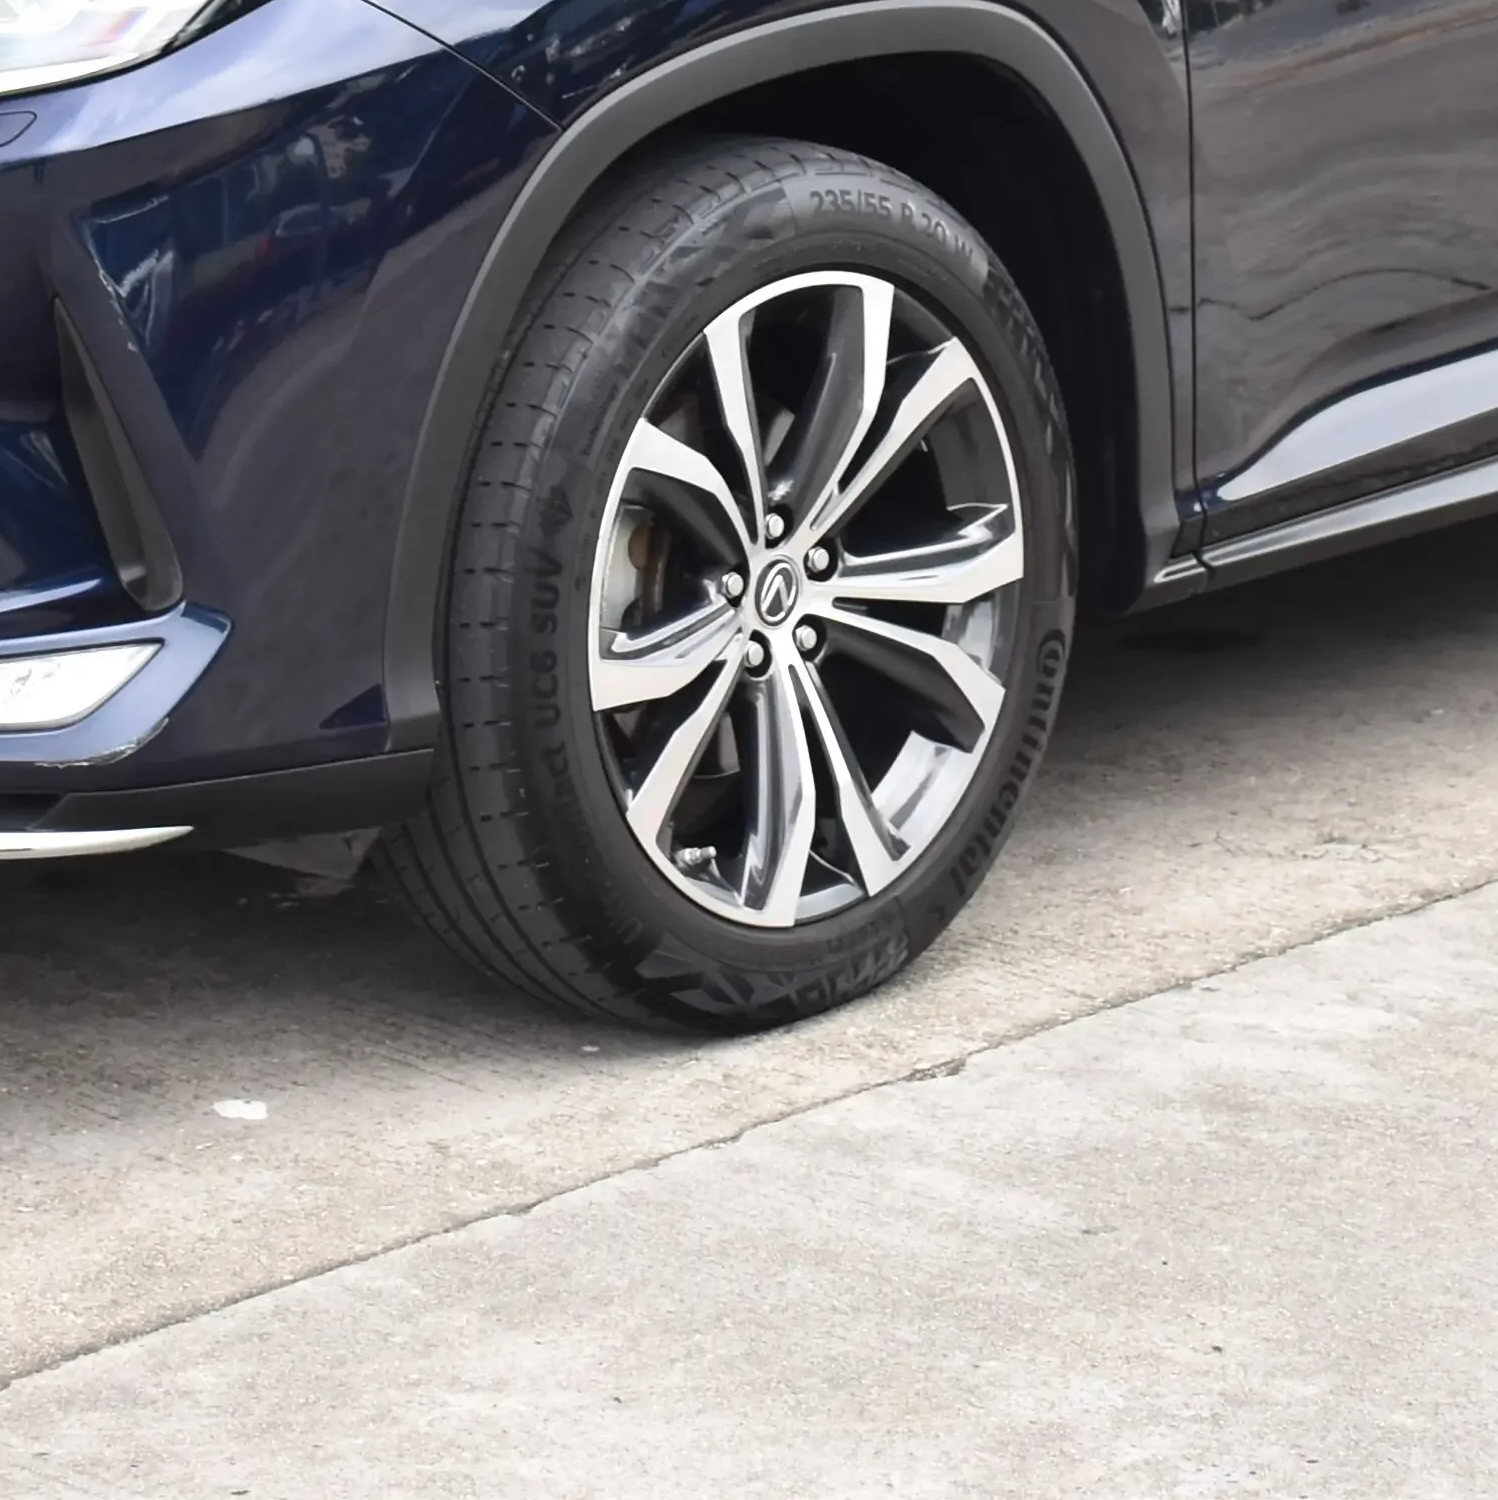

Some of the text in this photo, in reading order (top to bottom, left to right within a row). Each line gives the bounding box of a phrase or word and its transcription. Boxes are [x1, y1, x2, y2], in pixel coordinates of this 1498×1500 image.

[809, 189, 892, 218] 235/55
[901, 201, 917, 223] R
[526, 547, 563, 635] SUV
[530, 649, 563, 731] UC6
[950, 628, 1066, 897] Continental
